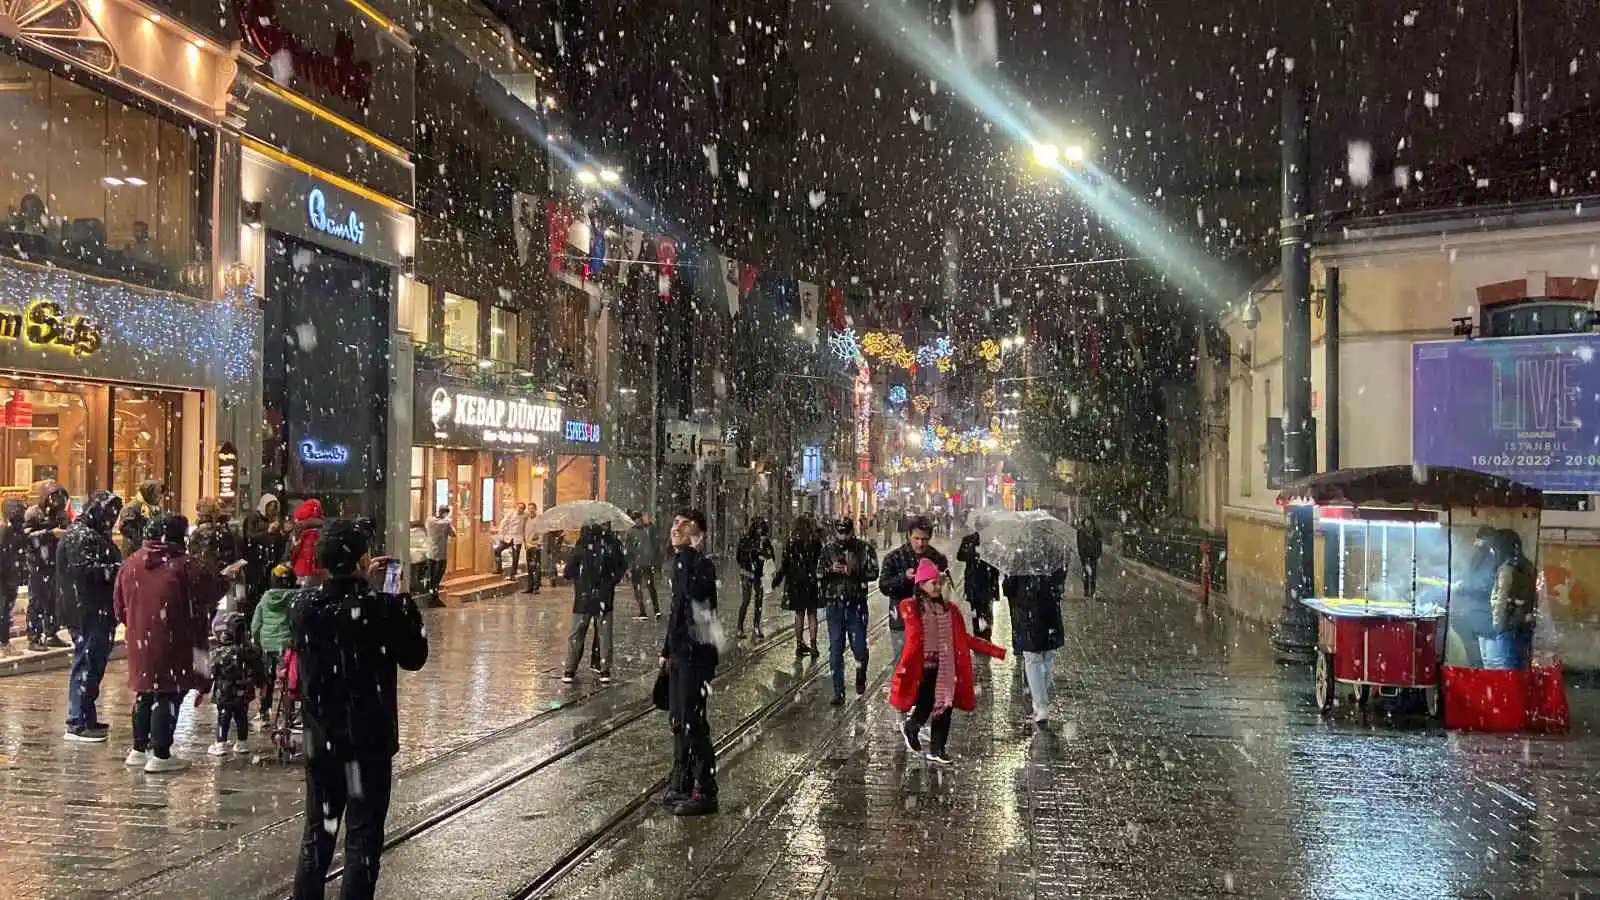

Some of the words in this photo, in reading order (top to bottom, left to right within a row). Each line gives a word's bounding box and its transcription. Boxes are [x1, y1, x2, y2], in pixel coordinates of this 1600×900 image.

[308, 188, 364, 244] Bambi
[454, 394, 506, 428] KEBAP
[507, 398, 563, 432] DÜNYASI
[1493, 358, 1581, 429] LIVE
[1471, 455, 1551, 466] 16/02/2023
